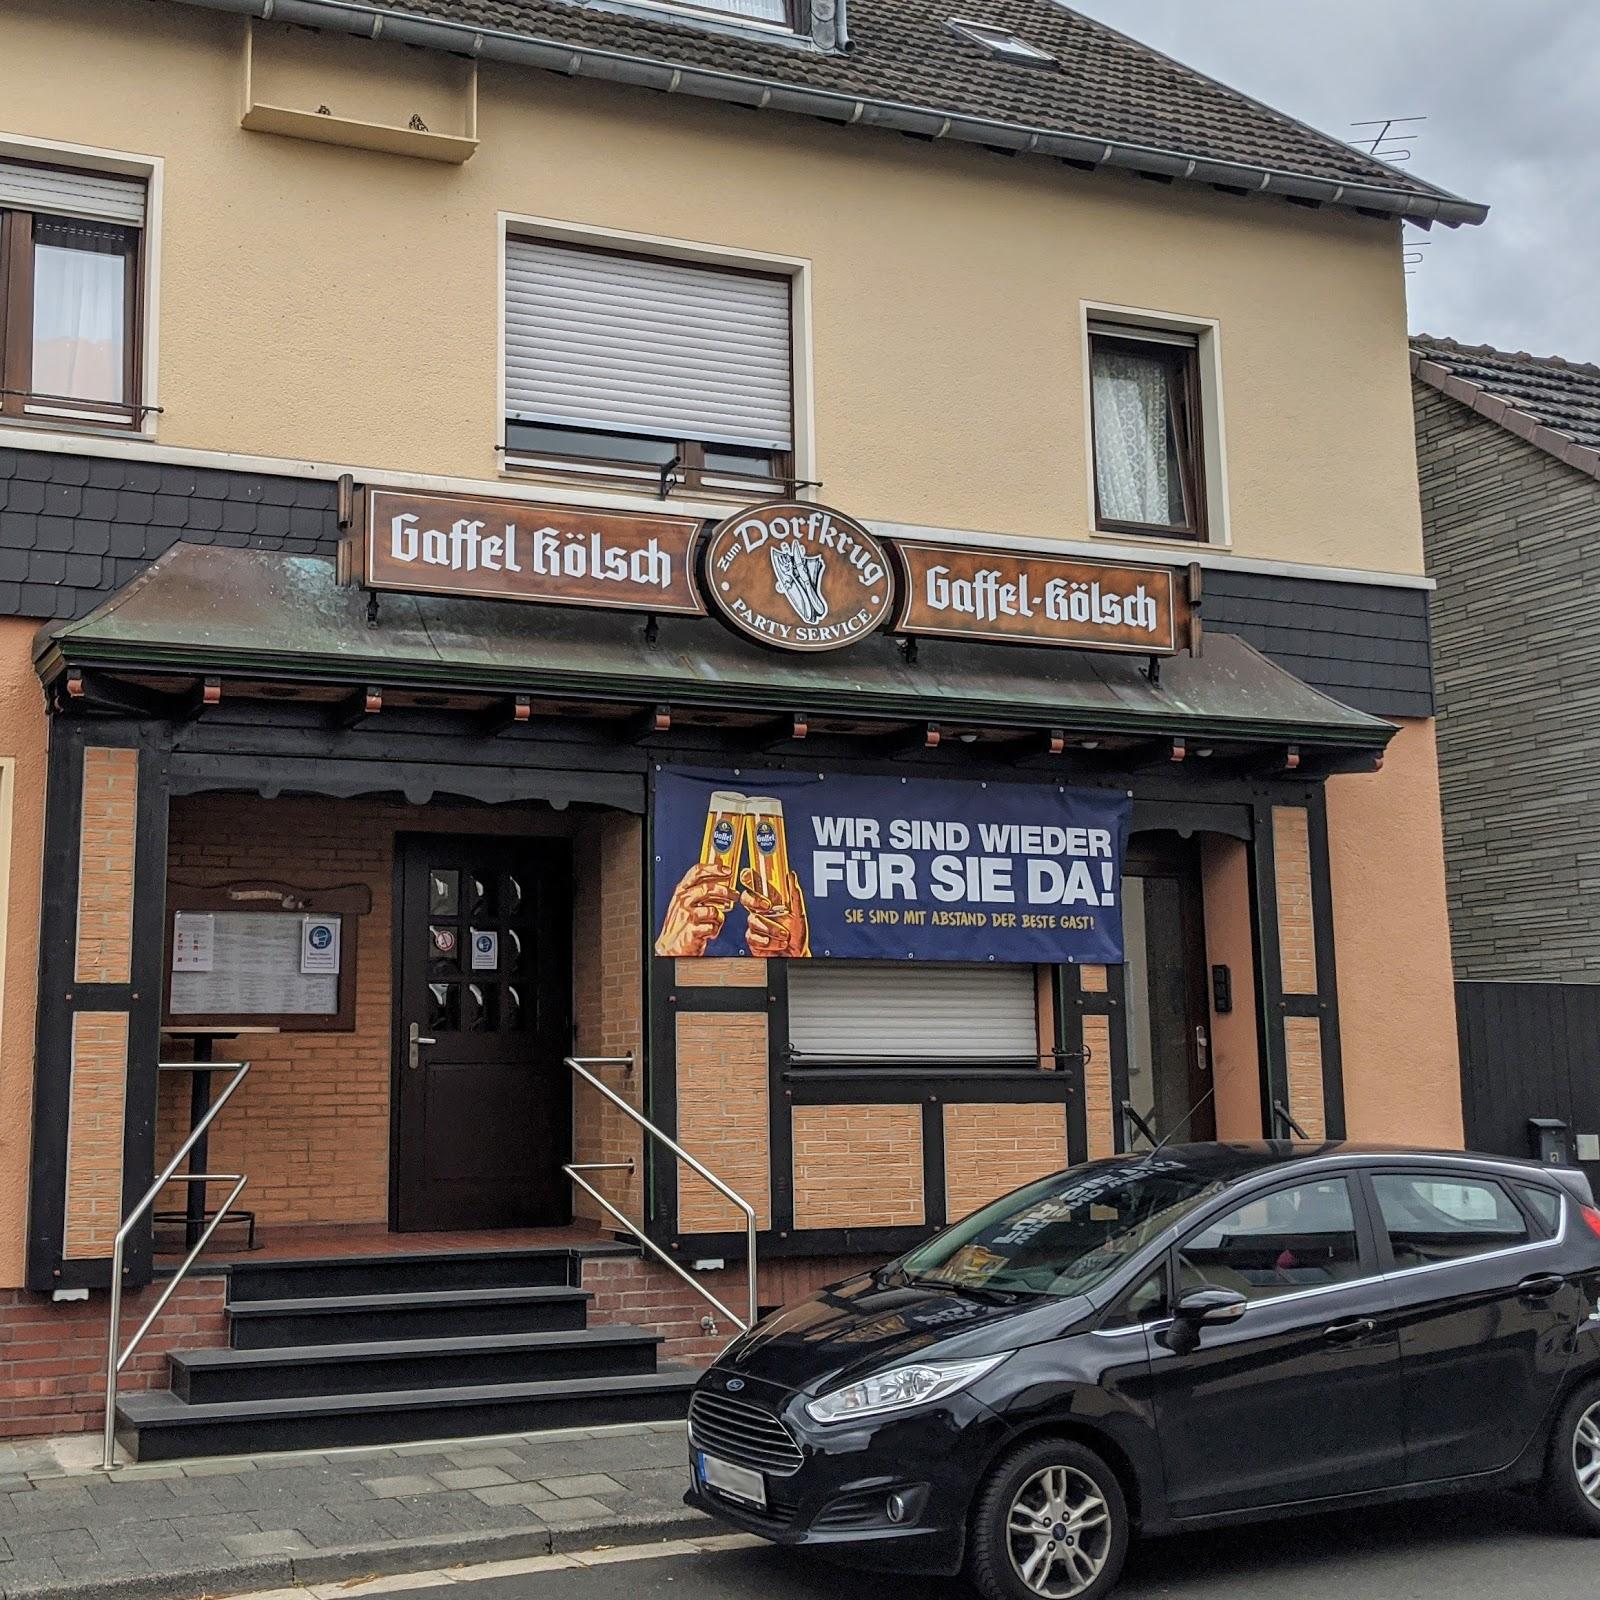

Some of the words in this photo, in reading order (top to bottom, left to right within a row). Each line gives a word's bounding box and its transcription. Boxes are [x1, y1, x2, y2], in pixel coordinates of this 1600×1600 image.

[391, 512, 521, 572] Gaffel
[533, 526, 671, 589] Kölsch
[717, 542, 742, 572] Zum
[733, 512, 884, 586] Dorfkrug
[731, 598, 792, 639] PARTY
[795, 608, 873, 641] SERVICE
[926, 565, 1156, 632] Gaffel-Kölsch
[811, 816, 881, 848] WIR
[888, 819, 970, 851] SIND
[977, 823, 1113, 858] WIEDER
[813, 850, 918, 900] FÜR
[930, 854, 1015, 903] SIE
[1027, 859, 1115, 907] DA!
[844, 908, 864, 924] SIE
[869, 909, 900, 924] SIND
[904, 910, 927, 926] MIT
[931, 911, 987, 927] ABSTAND
[991, 912, 1017, 928] DER
[1021, 914, 1057, 930] BESTE
[1060, 915, 1096, 931] GAST!
